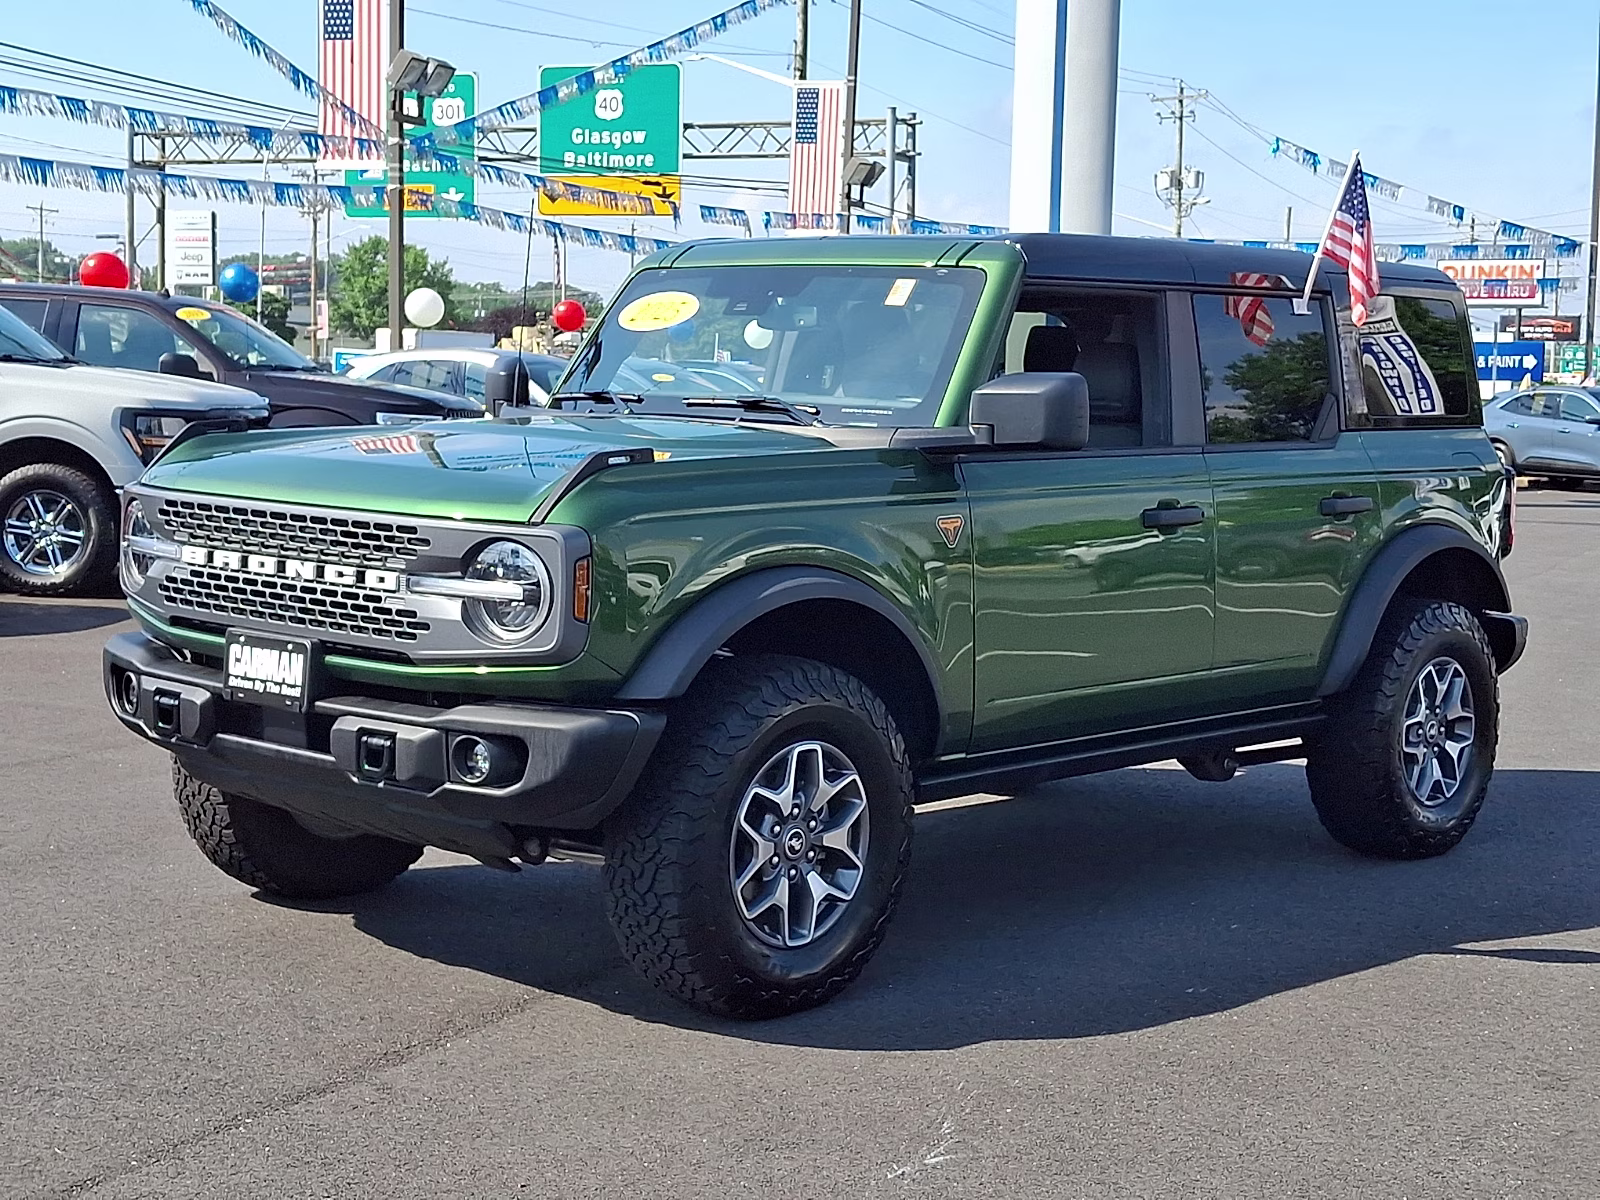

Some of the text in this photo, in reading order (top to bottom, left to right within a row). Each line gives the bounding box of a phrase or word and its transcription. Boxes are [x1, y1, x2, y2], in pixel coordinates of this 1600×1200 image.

[436, 104, 461, 120] 301
[598, 96, 619, 112] 40
[571, 127, 647, 150] Glasgow
[563, 151, 655, 168] Baltimore
[180, 251, 203, 264] Jeep
[1442, 264, 1541, 281] DUNKIN'
[1476, 355, 1486, 368] &
[181, 545, 399, 591] BRONCO
[228, 643, 304, 686] CARMAN
[228, 675, 254, 690] Driven
[254, 679, 266, 693] By
[266, 681, 281, 694] The
